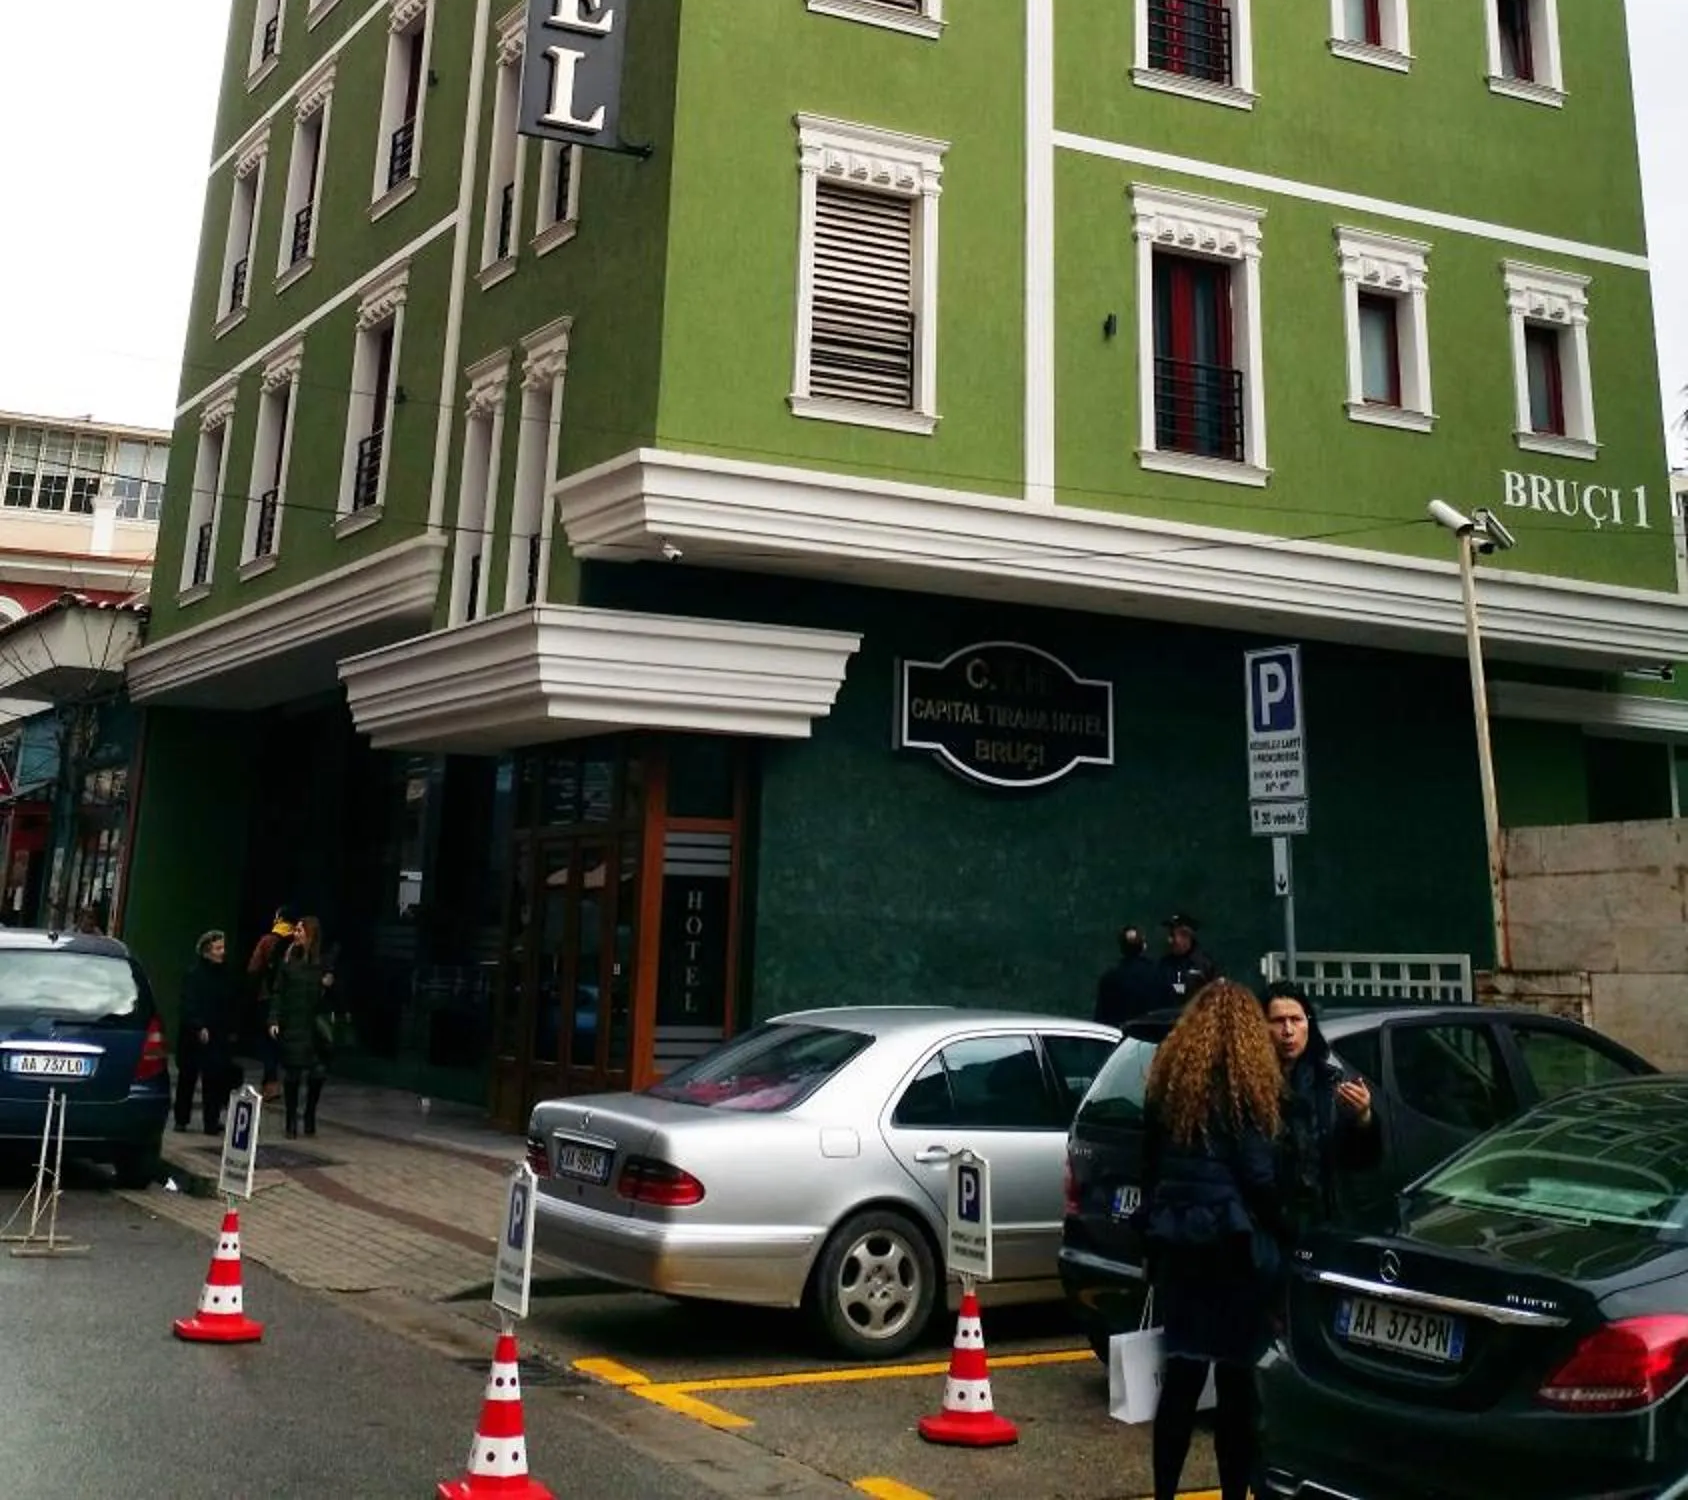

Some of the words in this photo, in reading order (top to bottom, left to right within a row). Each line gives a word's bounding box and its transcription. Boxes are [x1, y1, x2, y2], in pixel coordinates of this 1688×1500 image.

[1501, 469, 1623, 529] BRUÇI
[1632, 485, 1651, 528] 1
[911, 697, 983, 725] CAPITAL
[988, 705, 1050, 731] TIRANA
[1052, 711, 1106, 737] HOTEL
[1259, 662, 1286, 725] P
[975, 739, 1046, 771] BRUÇI
[685, 891, 702, 1012] HOTEL
[236, 1107, 249, 1143] P
[512, 1191, 524, 1238] P
[962, 1172, 976, 1214] P
[1353, 1302, 1376, 1336] AA
[1387, 1309, 1450, 1352] 373PN
